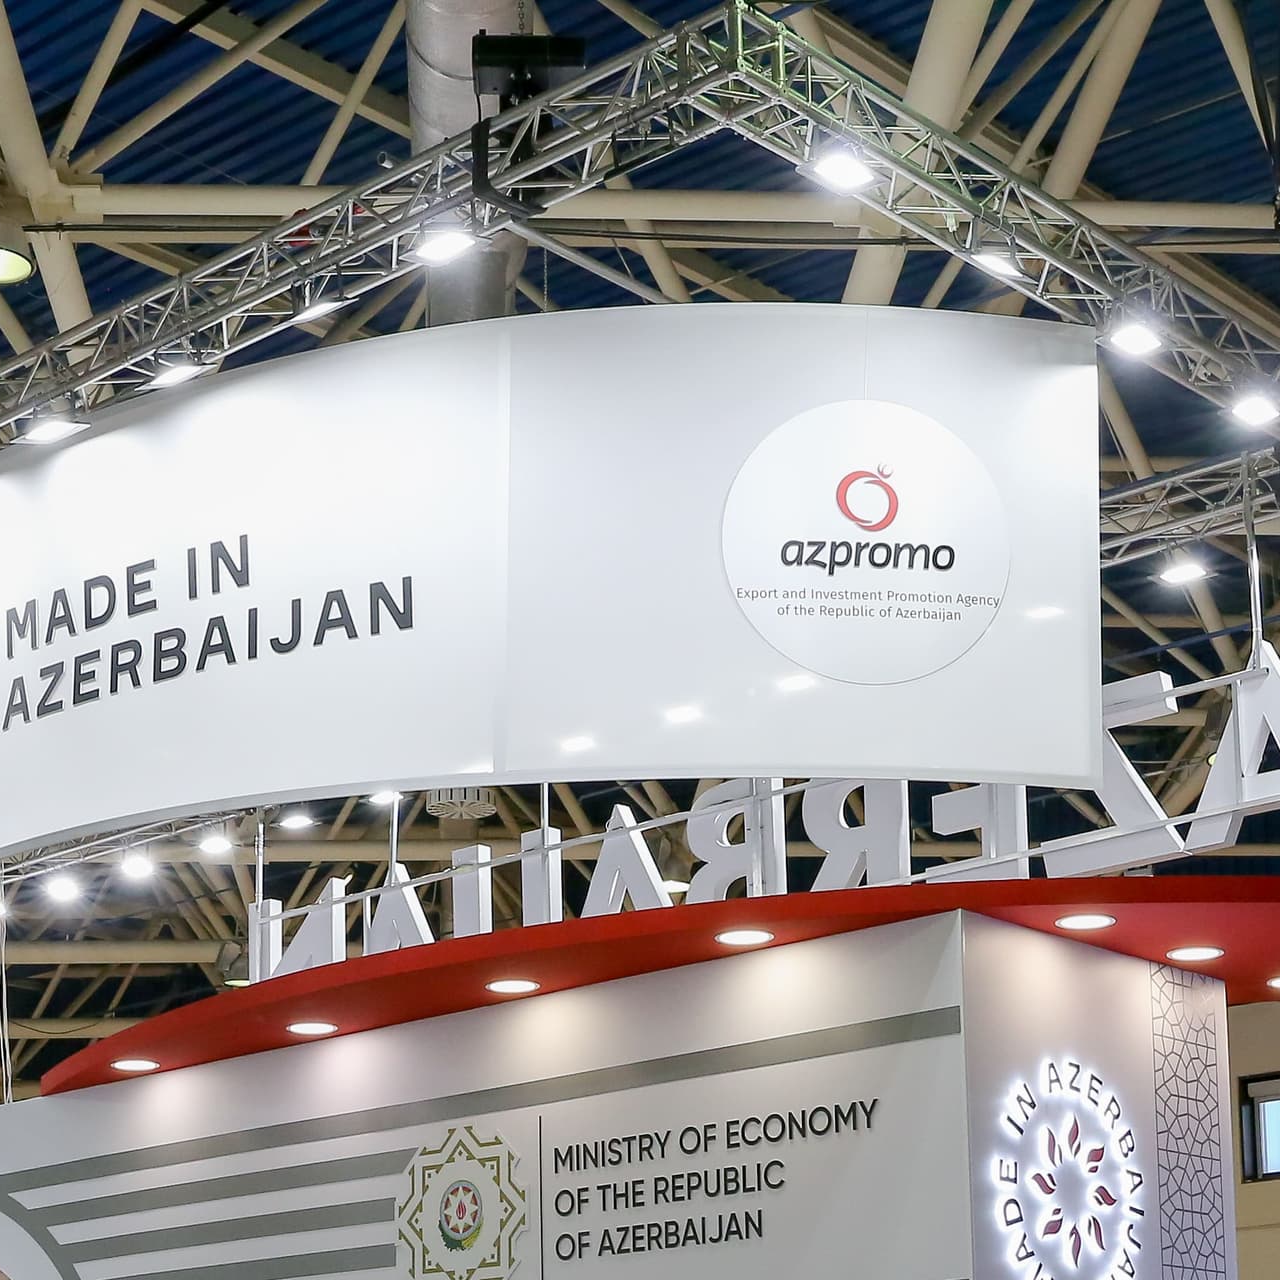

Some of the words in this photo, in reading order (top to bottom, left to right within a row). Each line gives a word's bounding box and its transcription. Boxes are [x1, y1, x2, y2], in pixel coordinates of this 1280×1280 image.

[780, 539, 956, 577] azpromo
[5, 558, 157, 660] MADE
[187, 533, 251, 600] IN
[736, 588, 778, 601] Export
[782, 588, 806, 600] and
[811, 589, 883, 602] Investment
[887, 590, 952, 604] Promotion
[956, 593, 1000, 609] Agency
[777, 604, 792, 616] of
[794, 605, 815, 617] the
[819, 605, 875, 619] Republic
[879, 606, 892, 618] of
[895, 607, 962, 623] Azerbaijan
[2, 575, 414, 732] AZERBAIJAN
[553, 1130, 671, 1174] MINISTRY
[678, 1123, 717, 1156] OF
[725, 1098, 880, 1149] ECONOMY
[1006, 1083, 1037, 1136] IN
[554, 1188, 590, 1217] OF
[596, 1176, 646, 1211] THE
[653, 1159, 786, 1205] REPUBLIC
[554, 1231, 590, 1261] OF
[597, 1208, 764, 1257] AZERBAIJAN
